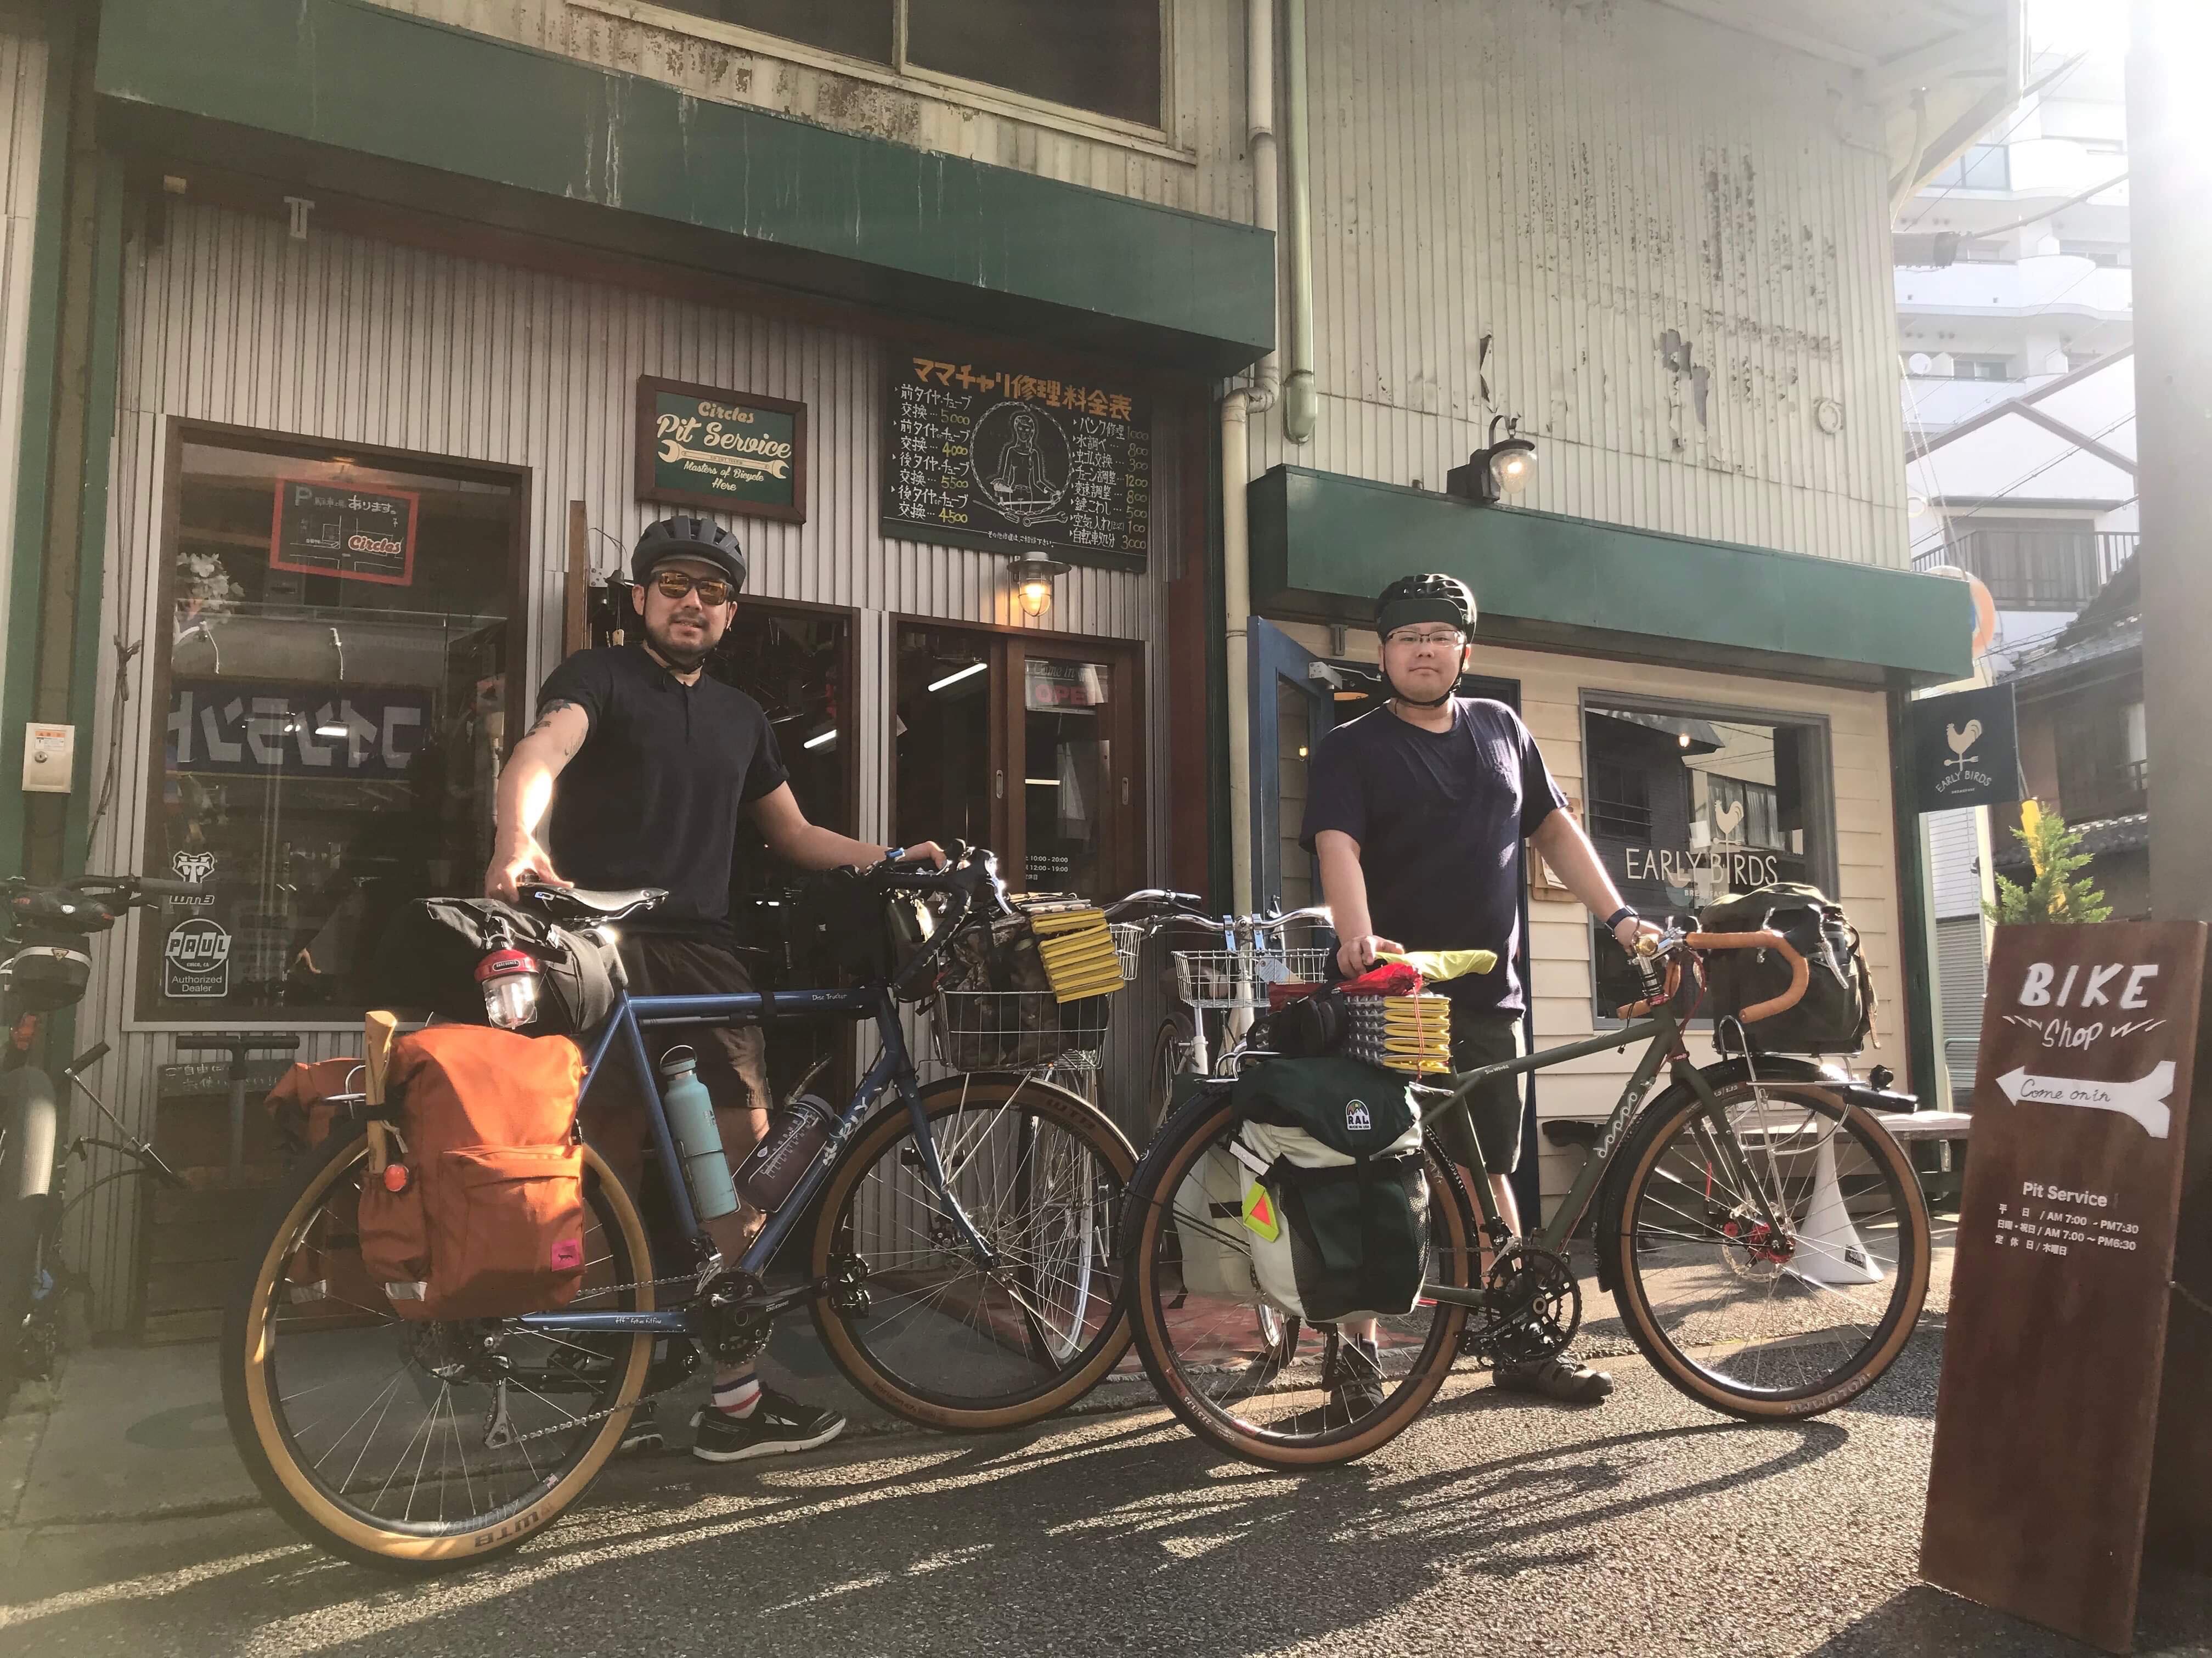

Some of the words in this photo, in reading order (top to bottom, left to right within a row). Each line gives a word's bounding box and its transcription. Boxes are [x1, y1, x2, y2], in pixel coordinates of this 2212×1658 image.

[913, 357, 1132, 421] ママチャリ修理料金表
[698, 401, 754, 424] Circles
[941, 408, 970, 425] 5000
[656, 414, 702, 443] Pit
[703, 421, 791, 459] Service
[1080, 417, 1125, 440] パンク修理
[1127, 426, 1149, 440] 1000
[942, 442, 968, 457] 4000
[1128, 443, 1148, 457] 800
[684, 460, 717, 475] Masters
[720, 466, 730, 480] of
[733, 467, 764, 483] Bicycle
[1128, 458, 1148, 472] 300
[712, 477, 737, 492] Here
[941, 476, 968, 489] 5500
[1125, 474, 1148, 487] 1200
[295, 486, 312, 506] P
[1127, 490, 1147, 504] 800
[939, 507, 968, 523] 4500
[1126, 505, 1147, 518] 500
[1128, 520, 1146, 534] 100
[348, 535, 402, 554] Circles
[1073, 527, 1115, 548] 自転車処分
[1121, 535, 1146, 549] 3000
[1936, 772, 1961, 793] EARLY
[1965, 770, 1992, 786] BIRDS
[1626, 848, 1702, 883] EARLY
[1710, 852, 1778, 886] BIRDS
[167, 937, 228, 954] PAUL
[172, 975, 222, 984] Authorized
[2019, 963, 2159, 1008] BIKE
[2042, 1019, 2103, 1051] Shop
[2021, 1079, 2063, 1100] Come
[1348, 1116, 1369, 1125] RAL
[2023, 1182, 2044, 1198] Pit
[2047, 1186, 2107, 1207] Service
[2047, 1212, 2063, 1222] AM
[2065, 1214, 2087, 1226] 7:00
[2101, 1220, 2139, 1234] PM7:30
[2044, 1227, 2060, 1238] AM
[2063, 1230, 2085, 1242] 7:00
[2097, 1236, 2136, 1251] PM6:30
